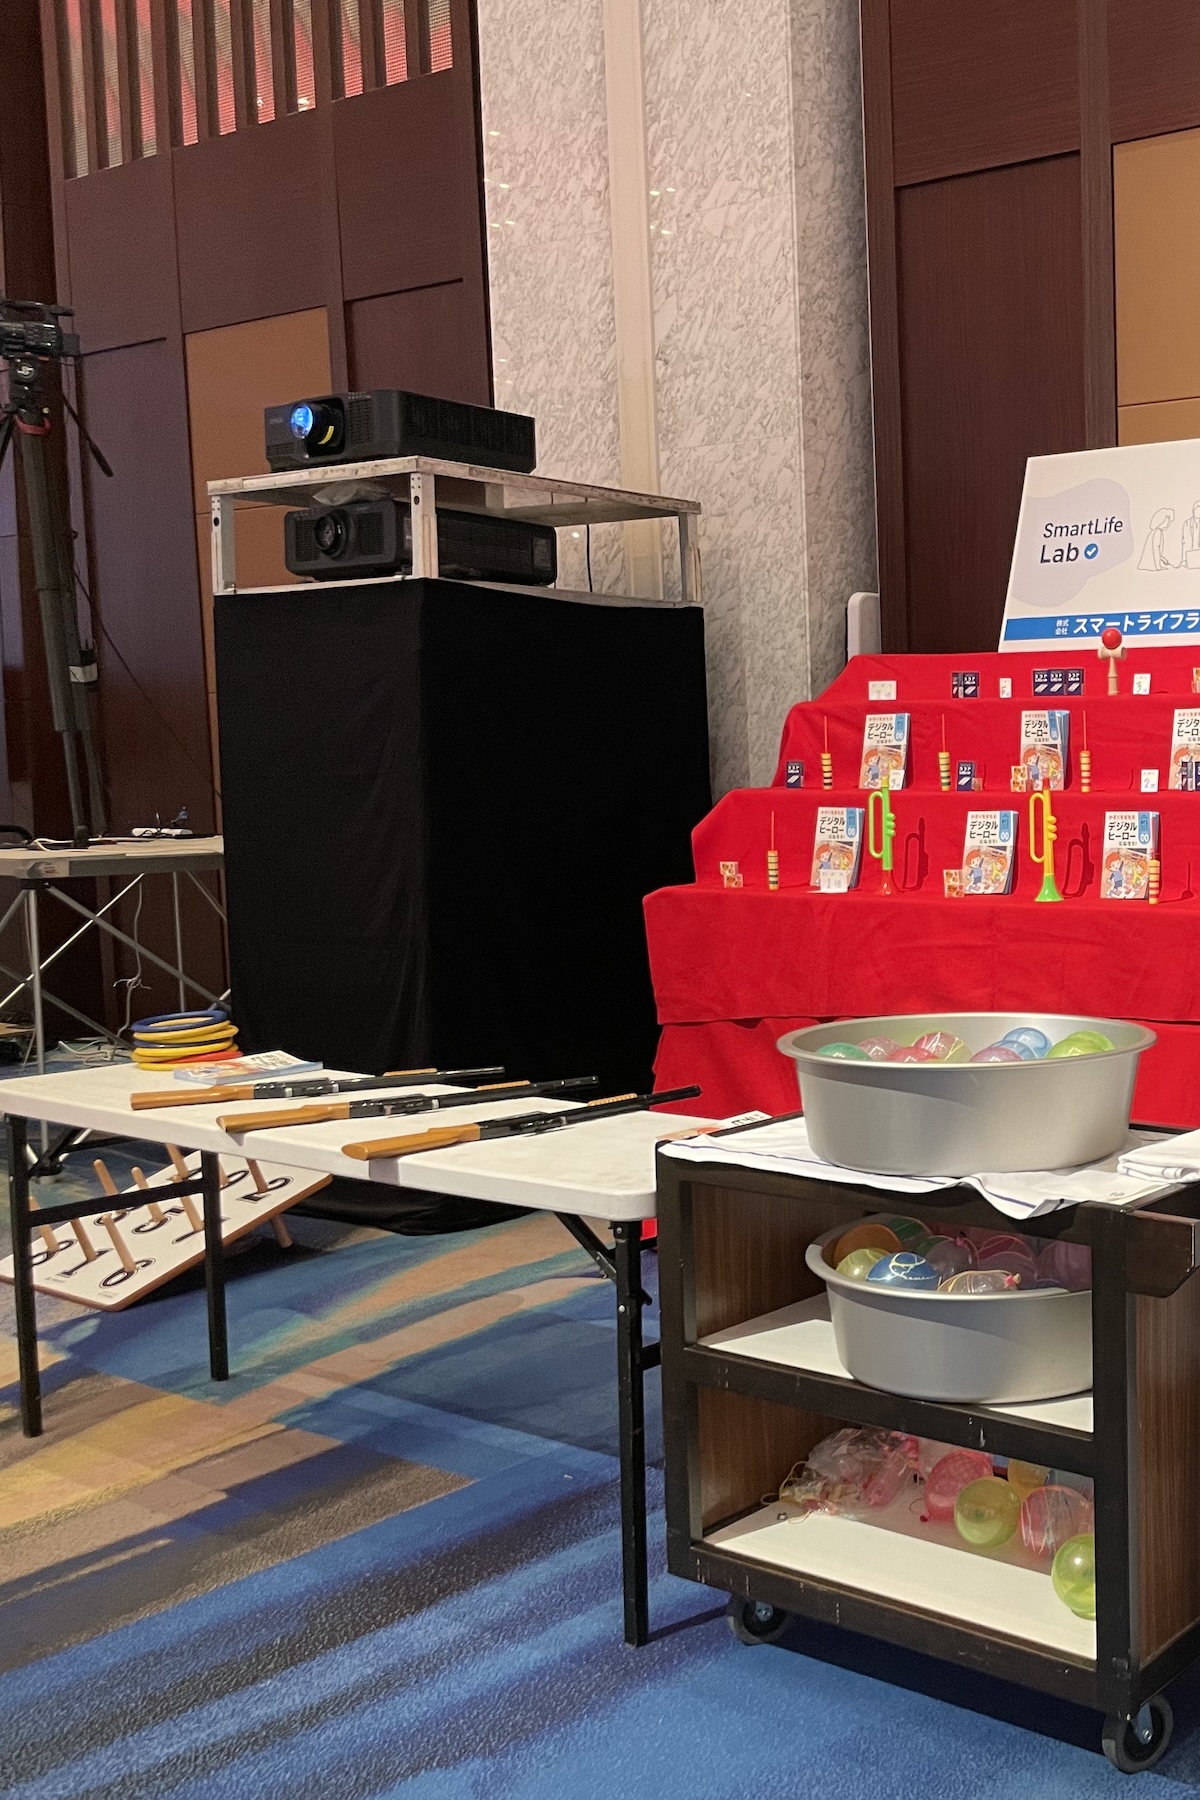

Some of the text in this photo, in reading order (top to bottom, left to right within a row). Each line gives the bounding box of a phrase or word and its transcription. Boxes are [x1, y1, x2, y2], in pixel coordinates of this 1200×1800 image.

[1043, 516, 1124, 539] SmartLife
[1040, 543, 1080, 564] Lab
[1056, 619, 1069, 627] 株式
[1055, 627, 1068, 635] 会社
[868, 723, 894, 731] デジタル
[1024, 720, 1048, 729] デジタル
[868, 731, 892, 739] ヒーロー
[1024, 729, 1048, 737] ヒーロー
[820, 816, 845, 826] デジタル
[970, 820, 998, 830] デジタル
[819, 826, 844, 834] ヒーロー
[1108, 822, 1138, 832] デジタル
[969, 830, 997, 839] ヒーロー
[1108, 832, 1136, 841] ヒーロー
